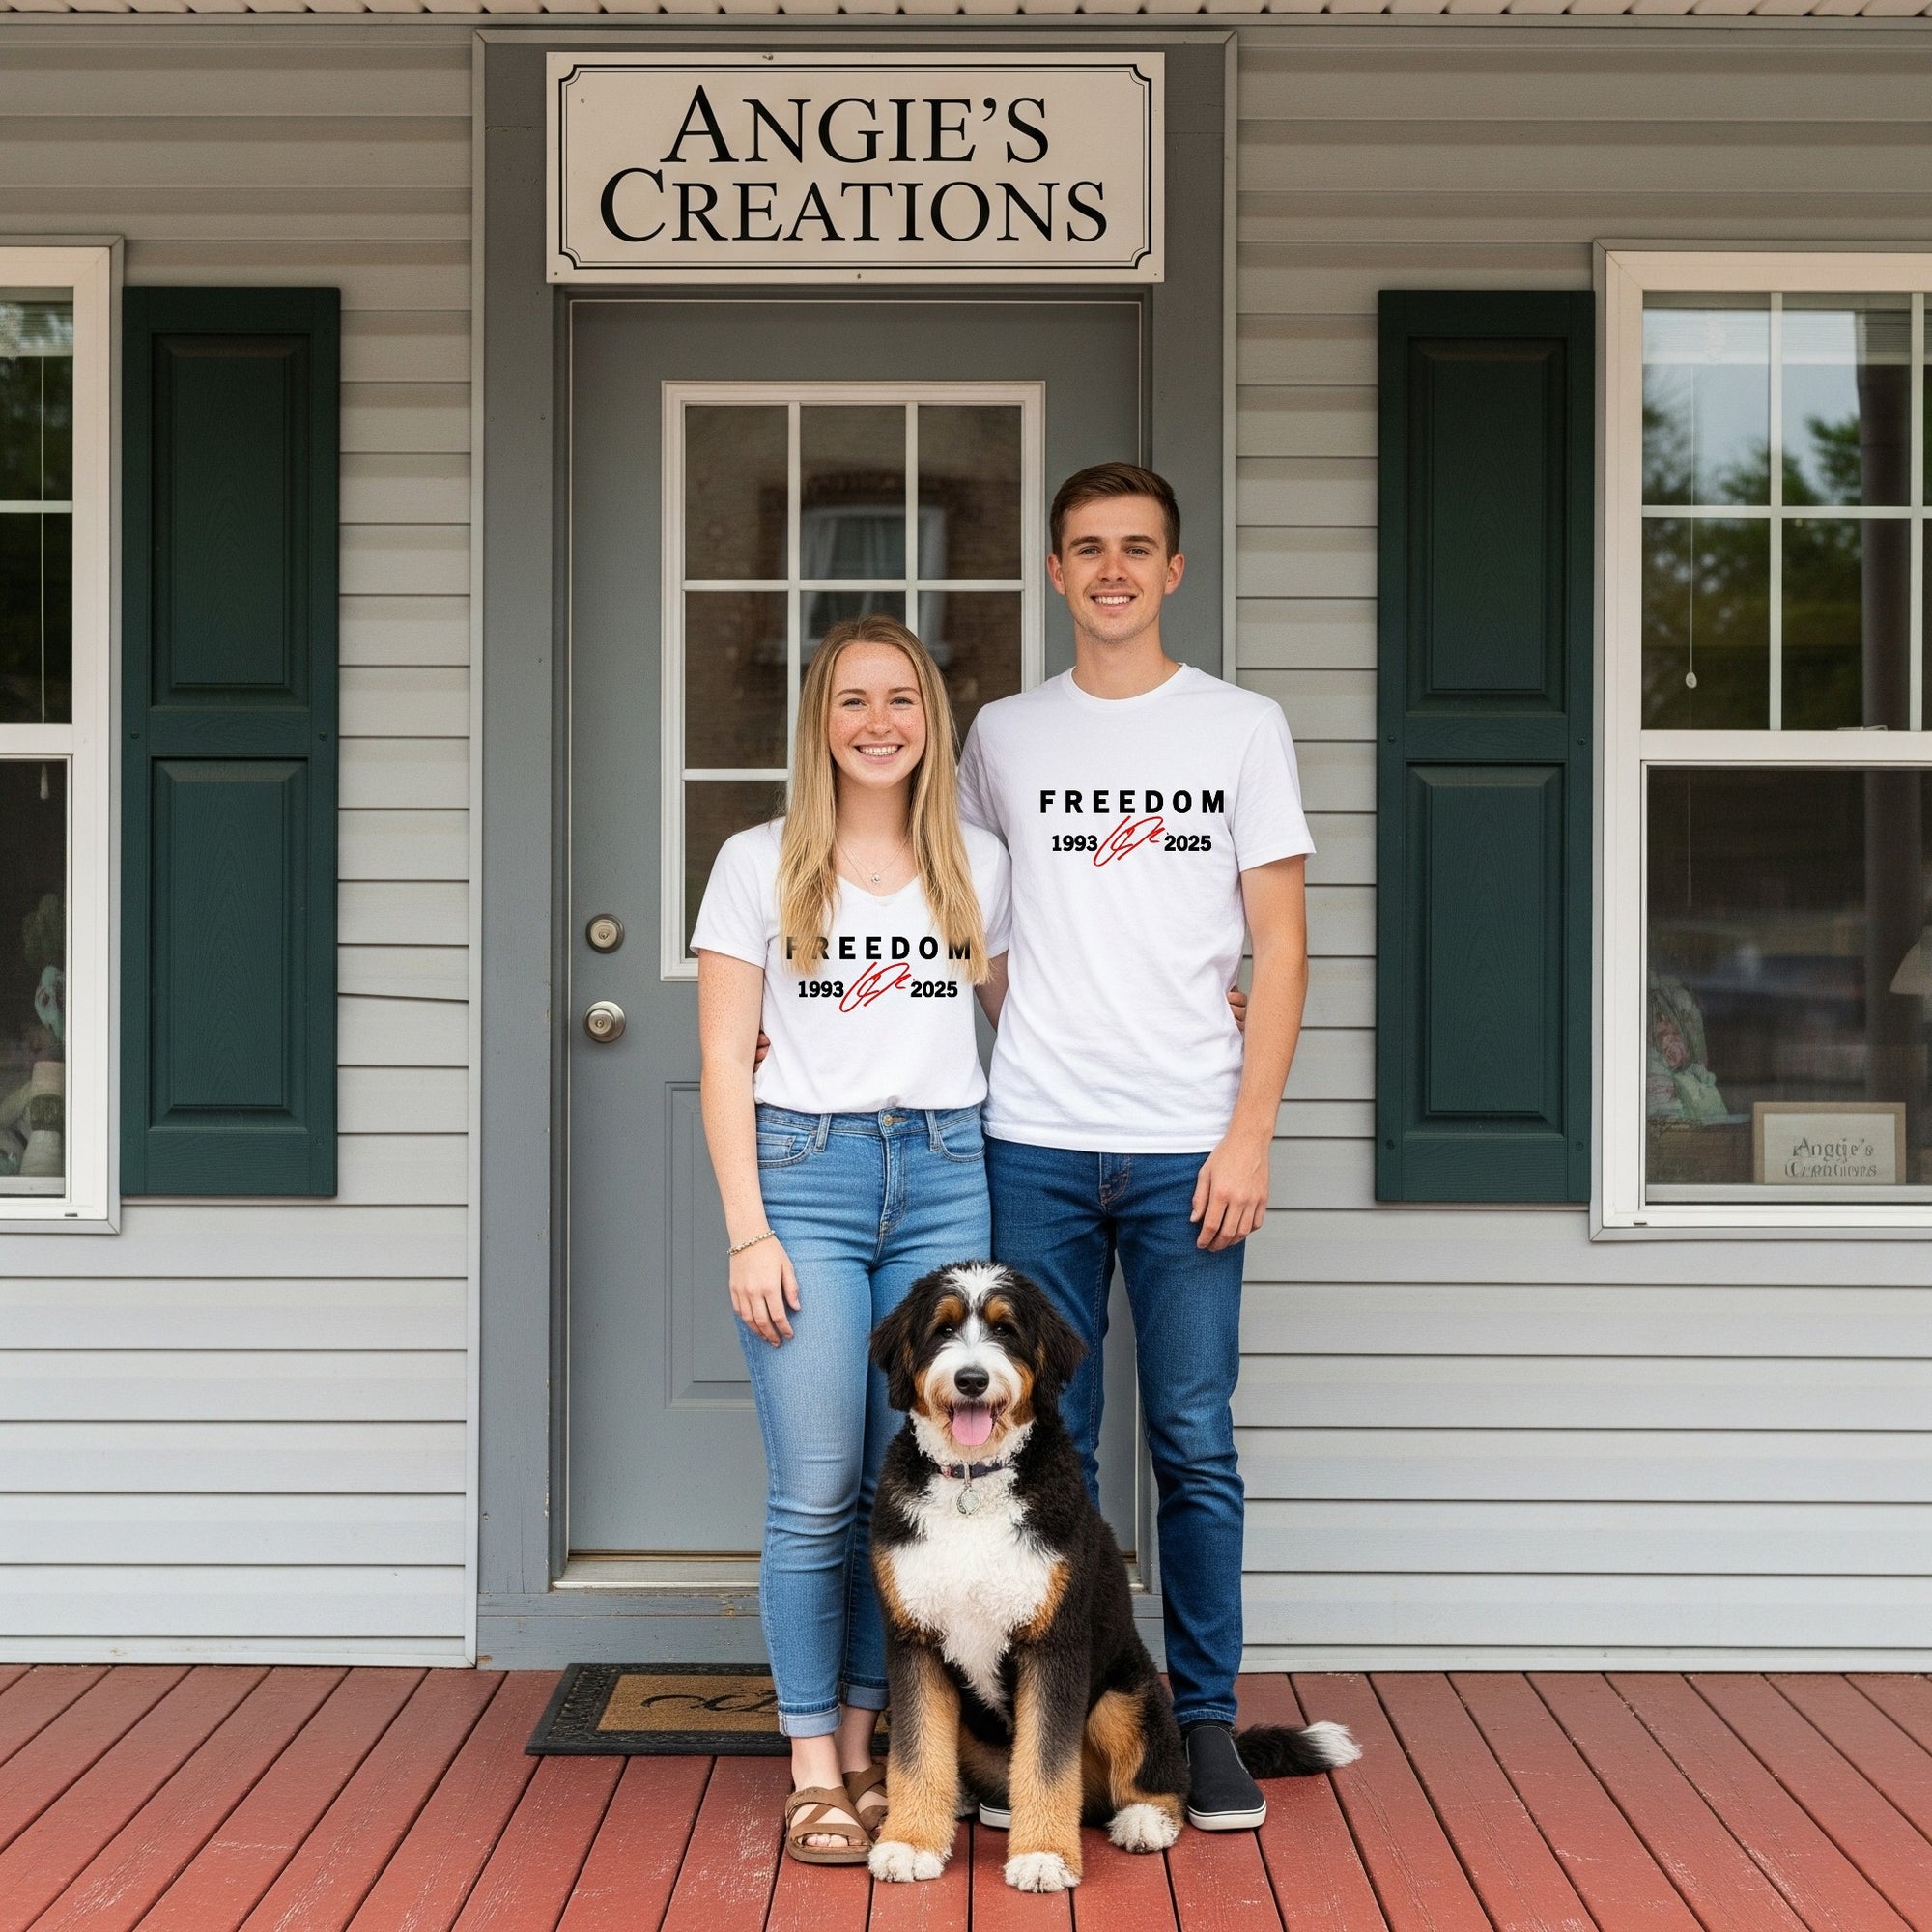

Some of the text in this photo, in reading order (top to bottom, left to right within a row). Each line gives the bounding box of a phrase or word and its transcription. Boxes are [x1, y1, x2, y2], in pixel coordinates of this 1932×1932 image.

[660, 84, 1049, 164] ANGIE'S
[600, 167, 1107, 242] CREATIONS
[1039, 790, 1225, 814] FREEDOM
[1052, 835, 1212, 852] 1993 2025
[798, 980, 958, 998] 1993 2025
